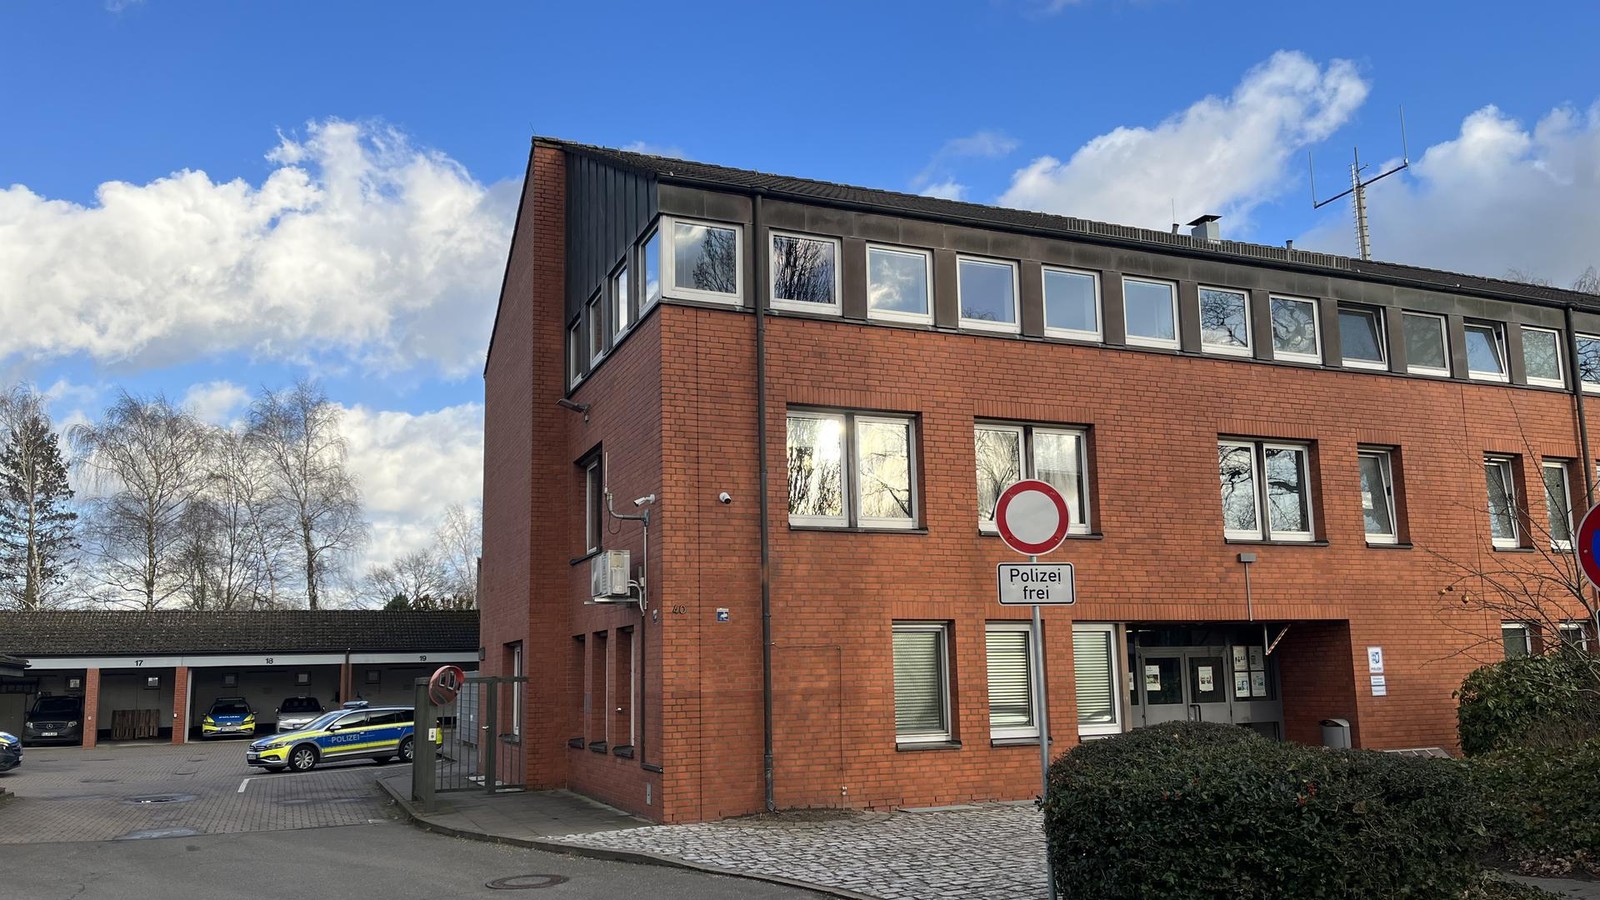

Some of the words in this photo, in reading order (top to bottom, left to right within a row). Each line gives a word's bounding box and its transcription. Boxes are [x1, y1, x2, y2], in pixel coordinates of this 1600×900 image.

[1010, 568, 1061, 582] Polizei
[1023, 585, 1049, 599] frei
[672, 604, 687, 614] 40
[331, 734, 360, 743] POLIZEI
